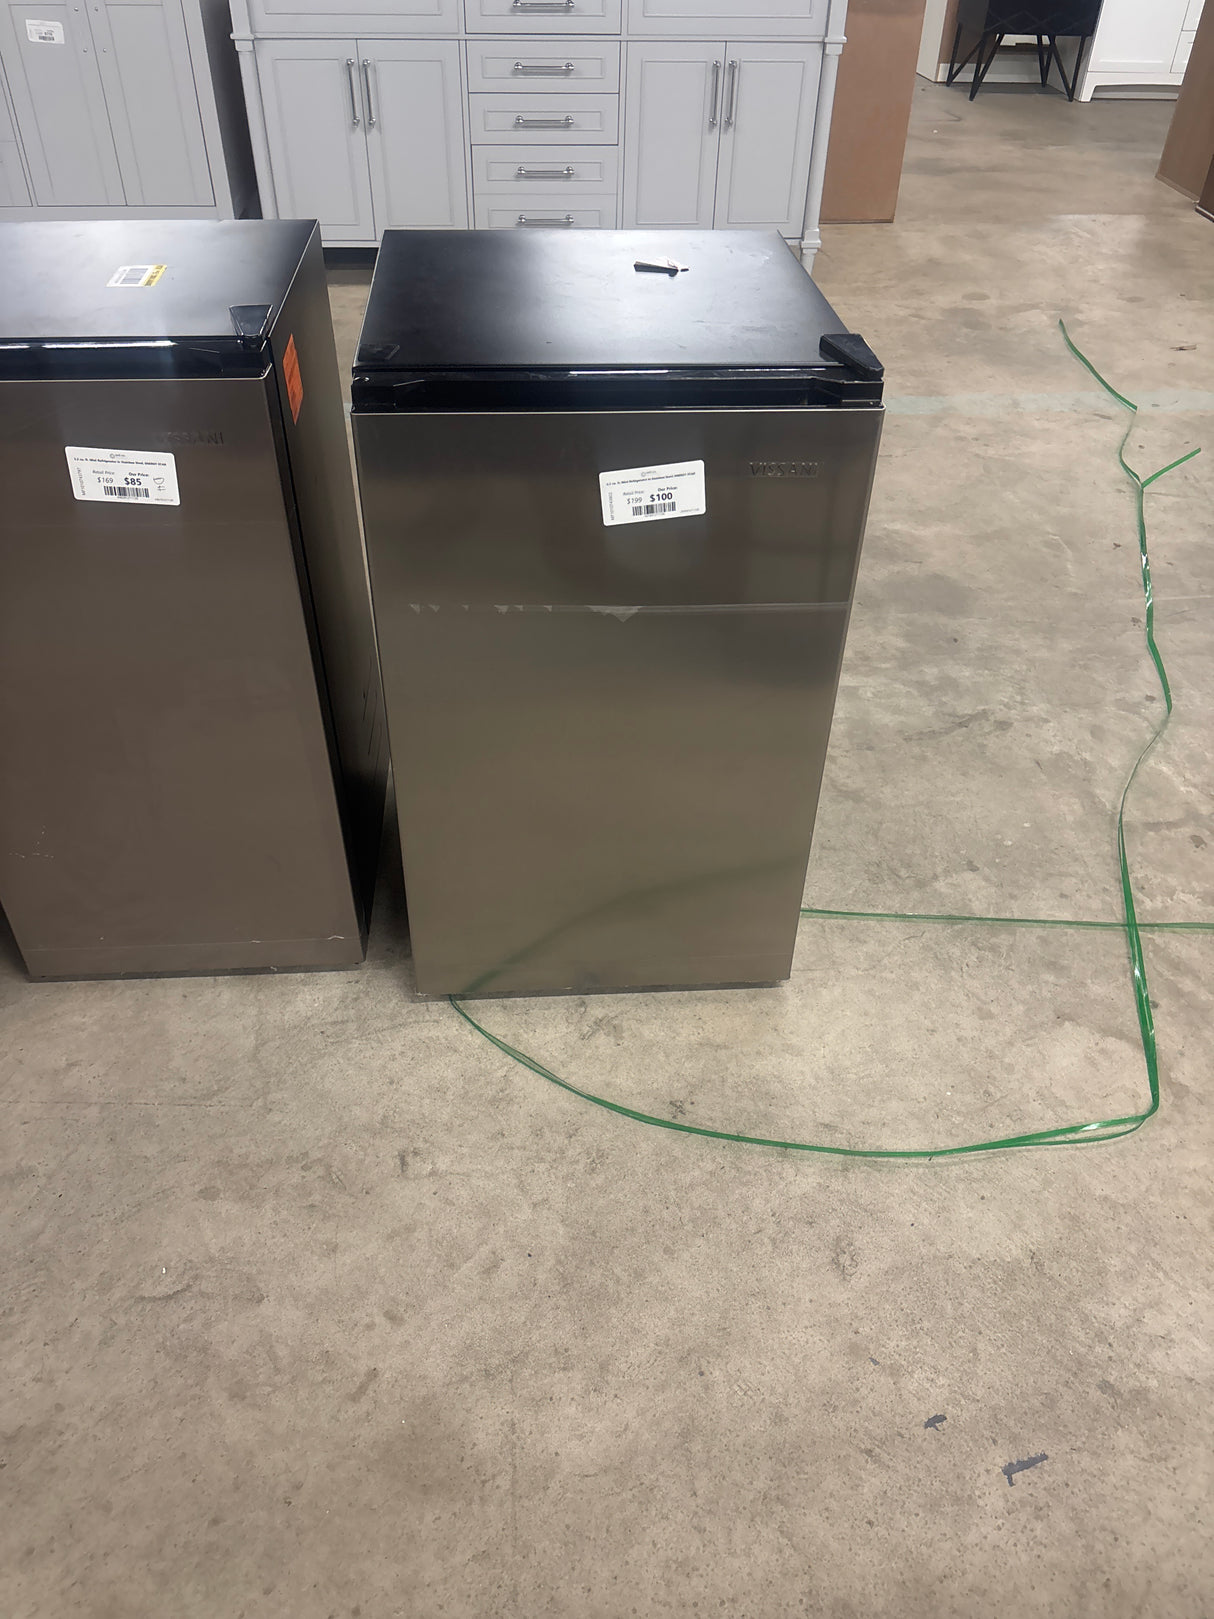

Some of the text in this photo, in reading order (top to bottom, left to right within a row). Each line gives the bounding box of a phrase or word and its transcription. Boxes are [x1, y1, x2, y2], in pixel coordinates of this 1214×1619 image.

[749, 462, 818, 476] VISSANI
[97, 476, 114, 484] $169
[124, 477, 142, 486] $85
[627, 496, 643, 505] $199
[649, 492, 673, 503] $100
